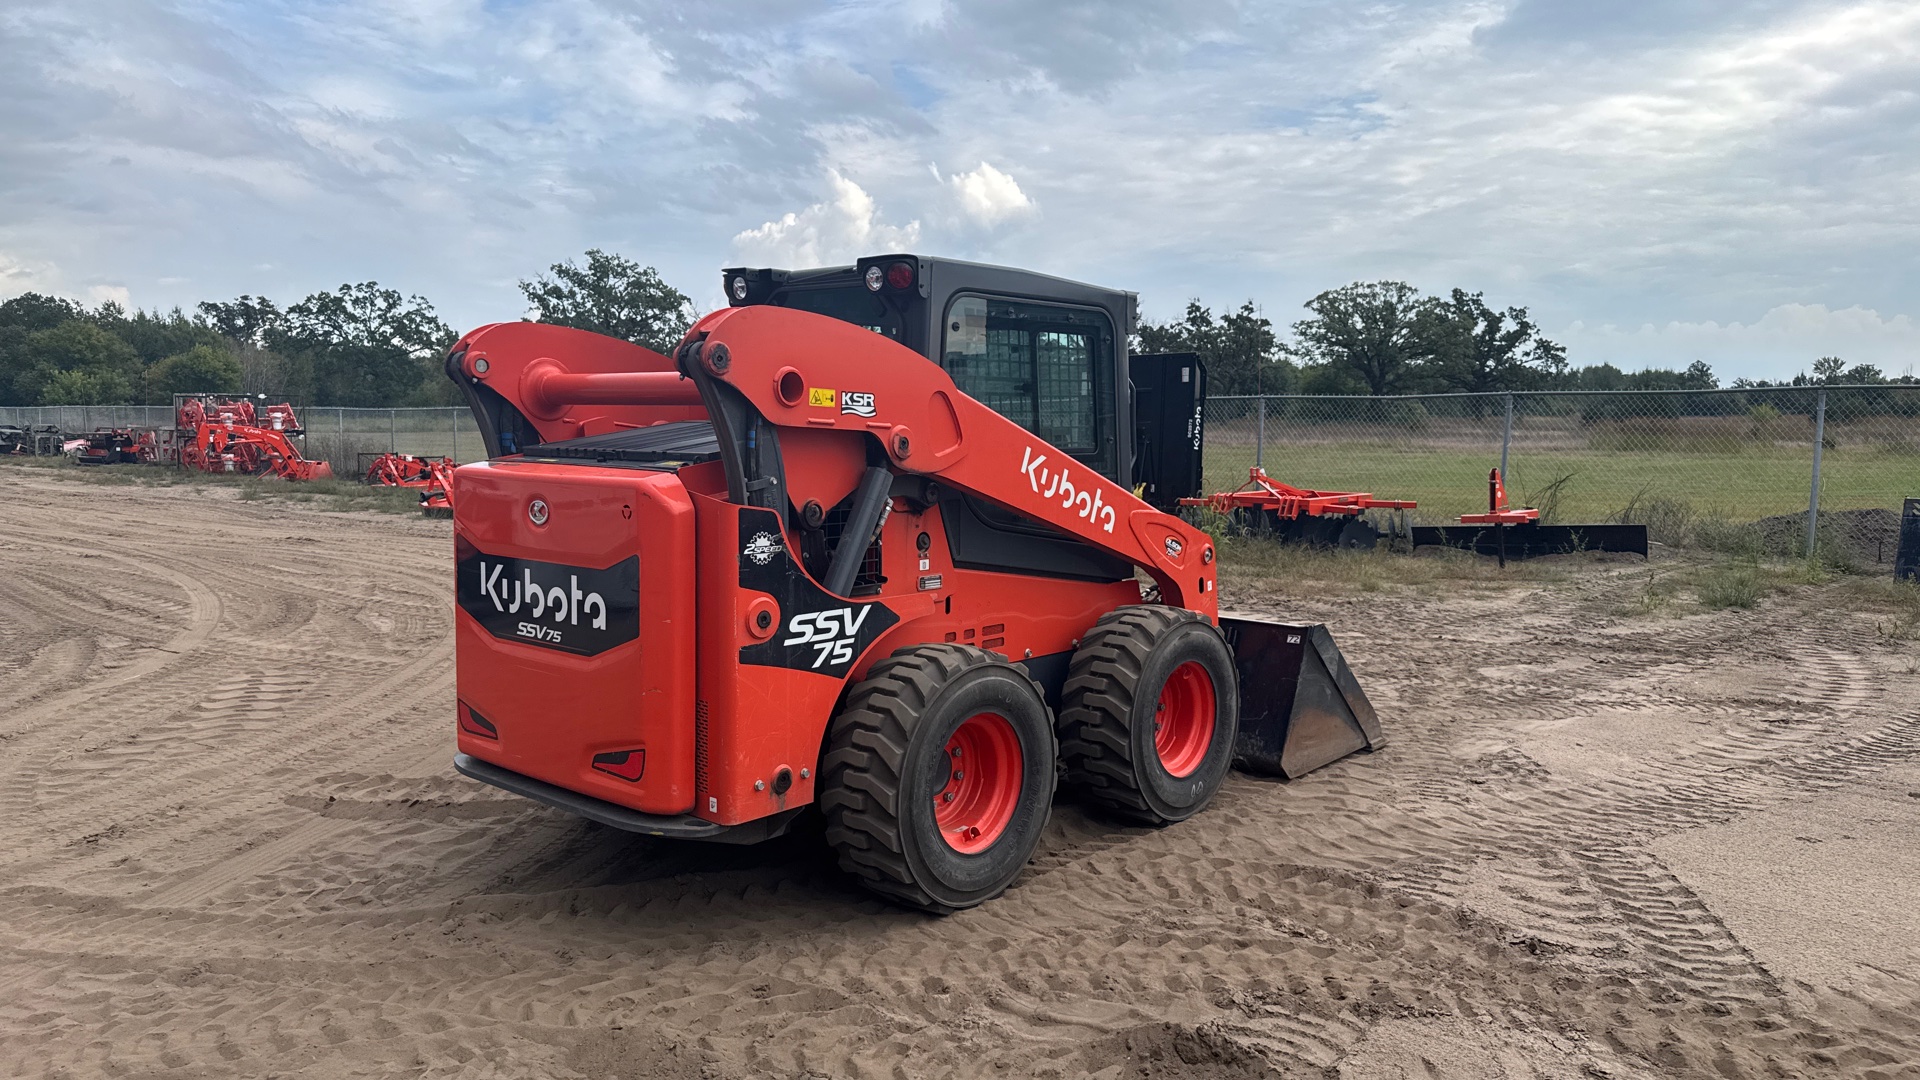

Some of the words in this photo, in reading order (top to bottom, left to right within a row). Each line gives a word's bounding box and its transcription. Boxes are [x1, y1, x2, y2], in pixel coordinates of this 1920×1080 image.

[841, 391, 875, 407] KSR
[1193, 406, 1202, 450] Kubota
[1020, 445, 1116, 534] Kubota
[480, 561, 607, 631] Kubota
[783, 604, 873, 647] SSV
[1289, 635, 1299, 643] 72
[811, 638, 855, 669] 75
